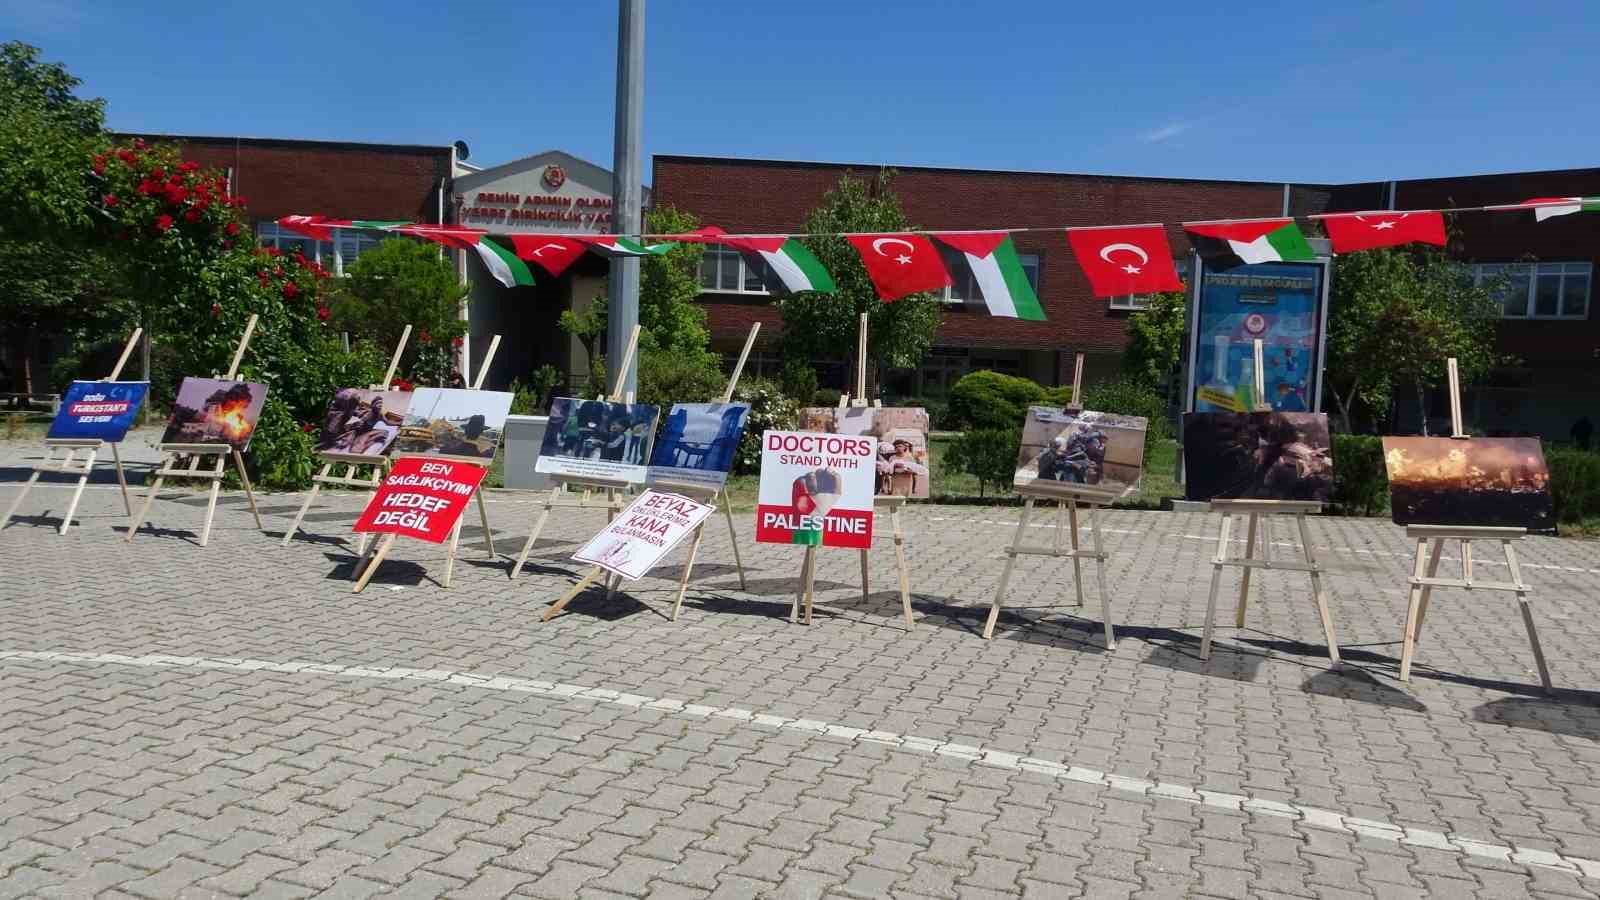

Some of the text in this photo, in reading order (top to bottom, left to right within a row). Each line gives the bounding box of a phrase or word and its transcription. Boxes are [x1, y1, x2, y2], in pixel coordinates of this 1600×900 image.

[525, 195, 572, 207] ADIMIN
[575, 197, 614, 208] OLDU
[768, 435, 871, 456] DOCTORS
[420, 462, 454, 476] BEN
[780, 454, 859, 469] STAND WITH
[386, 473, 473, 496] SAĞLIKÇIYIM
[382, 493, 452, 513] HEDEF
[645, 495, 699, 518] BEYAZ
[373, 510, 431, 532] DEĞİL
[625, 514, 671, 537] KANA
[763, 512, 867, 534] PALESTINE
[610, 526, 666, 548] BULANMASIN
